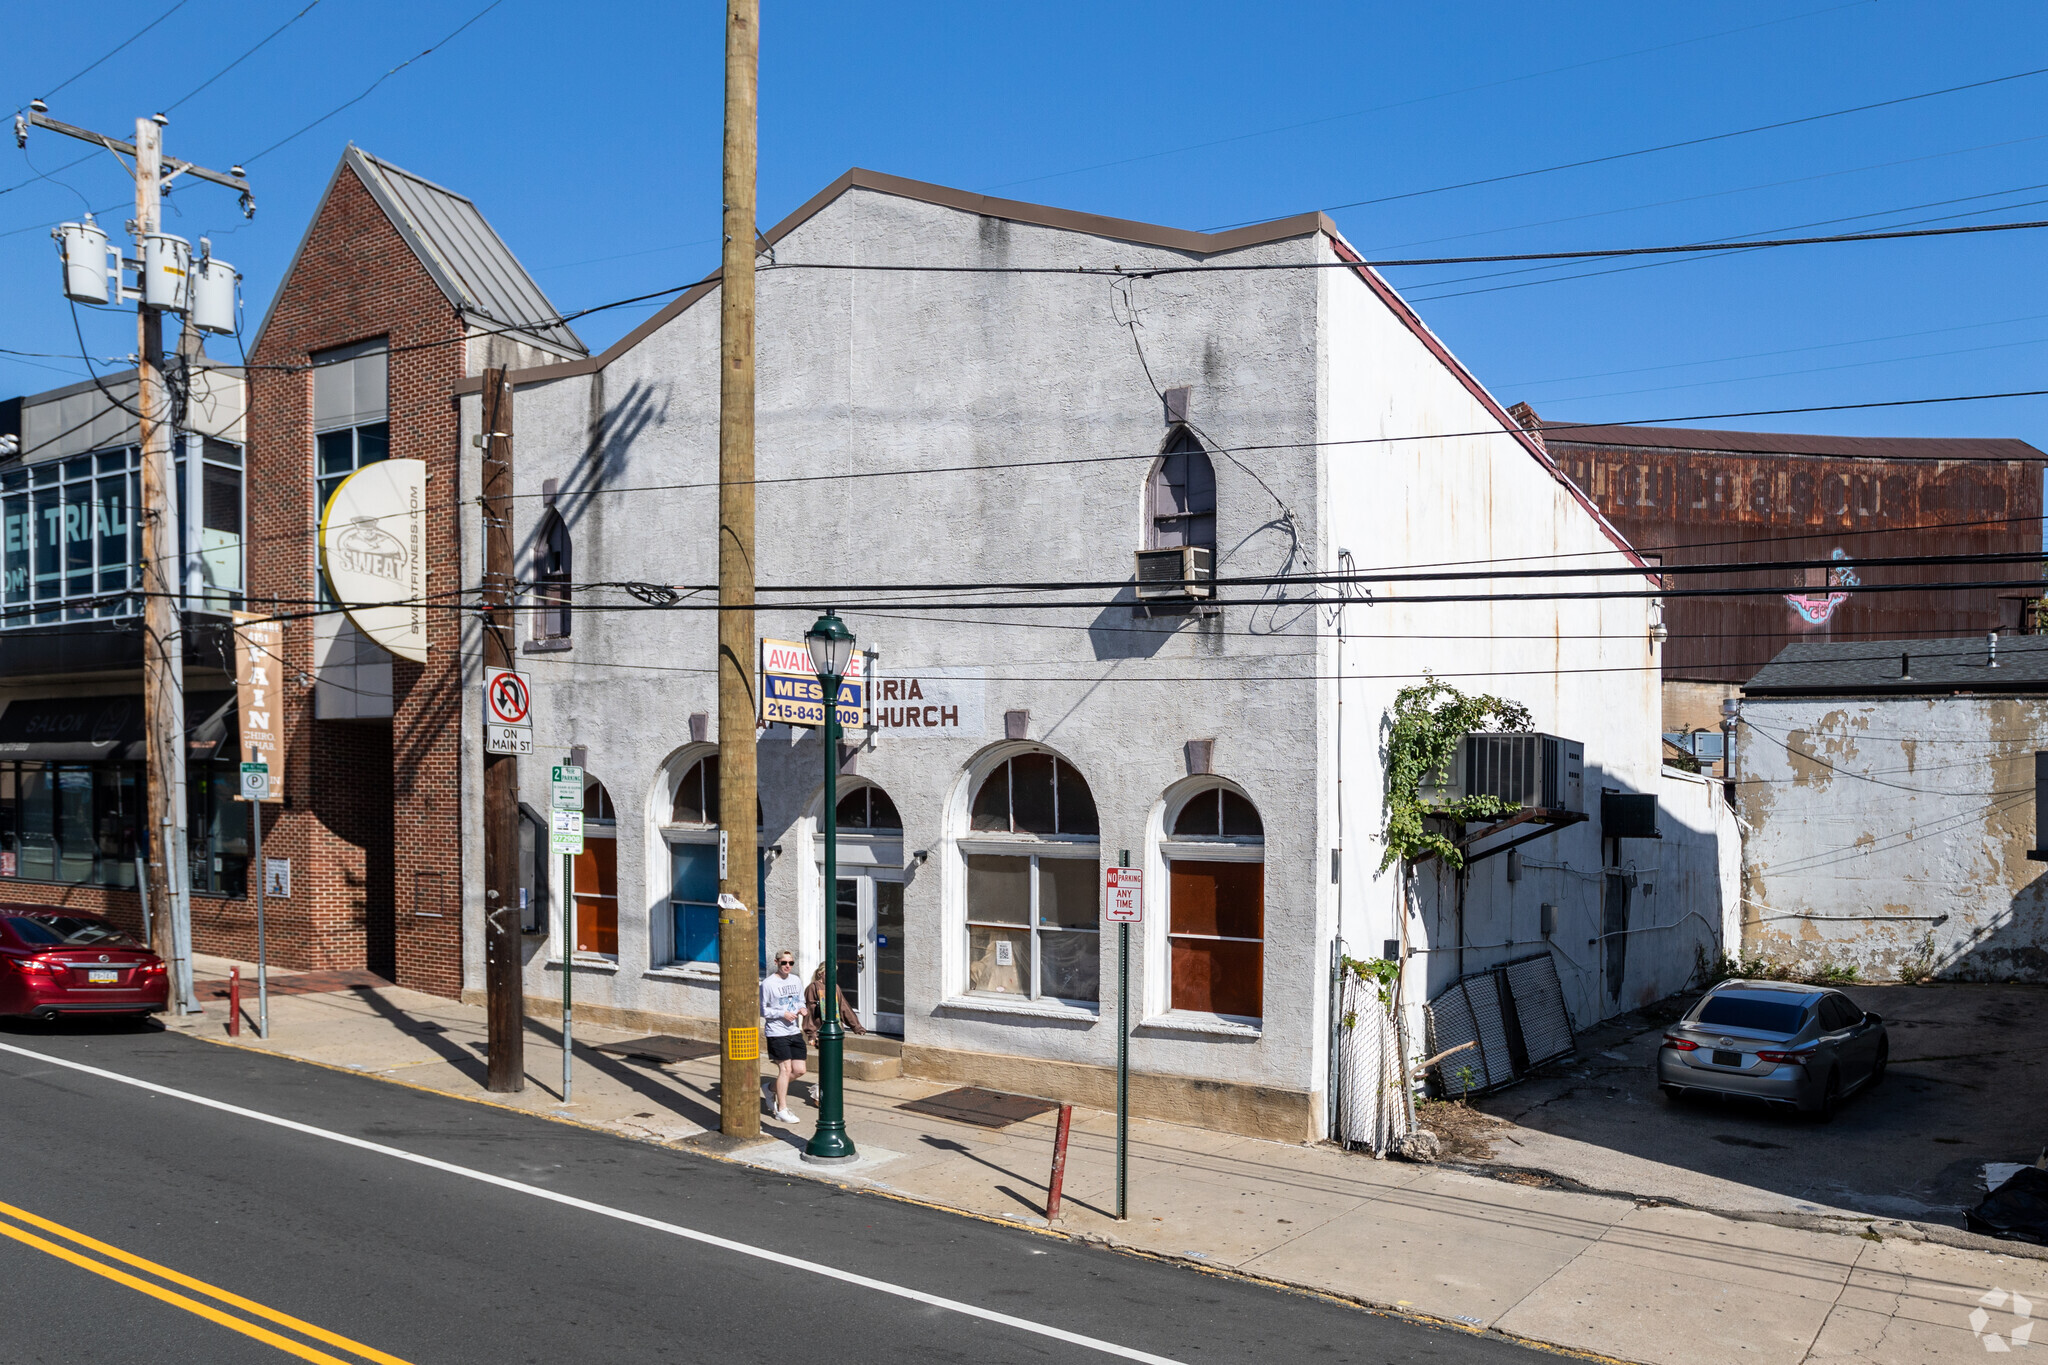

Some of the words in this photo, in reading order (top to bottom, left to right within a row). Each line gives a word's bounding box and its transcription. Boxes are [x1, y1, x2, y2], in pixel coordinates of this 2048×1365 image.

[44, 496, 127, 546] TRIAL
[340, 548, 406, 581] SWEAT
[769, 649, 860, 677] AVAILE
[247, 644, 271, 730] PAIN
[774, 680, 854, 703] MESA
[503, 729, 517, 739] ON
[492, 739, 517, 751] MAIN
[519, 741, 531, 751] ST
[554, 769, 560, 780] 2
[1108, 873, 1117, 883] NO
[1119, 875, 1141, 883] PARKING
[1117, 890, 1132, 898] ANY
[1116, 899, 1132, 908] TIME
